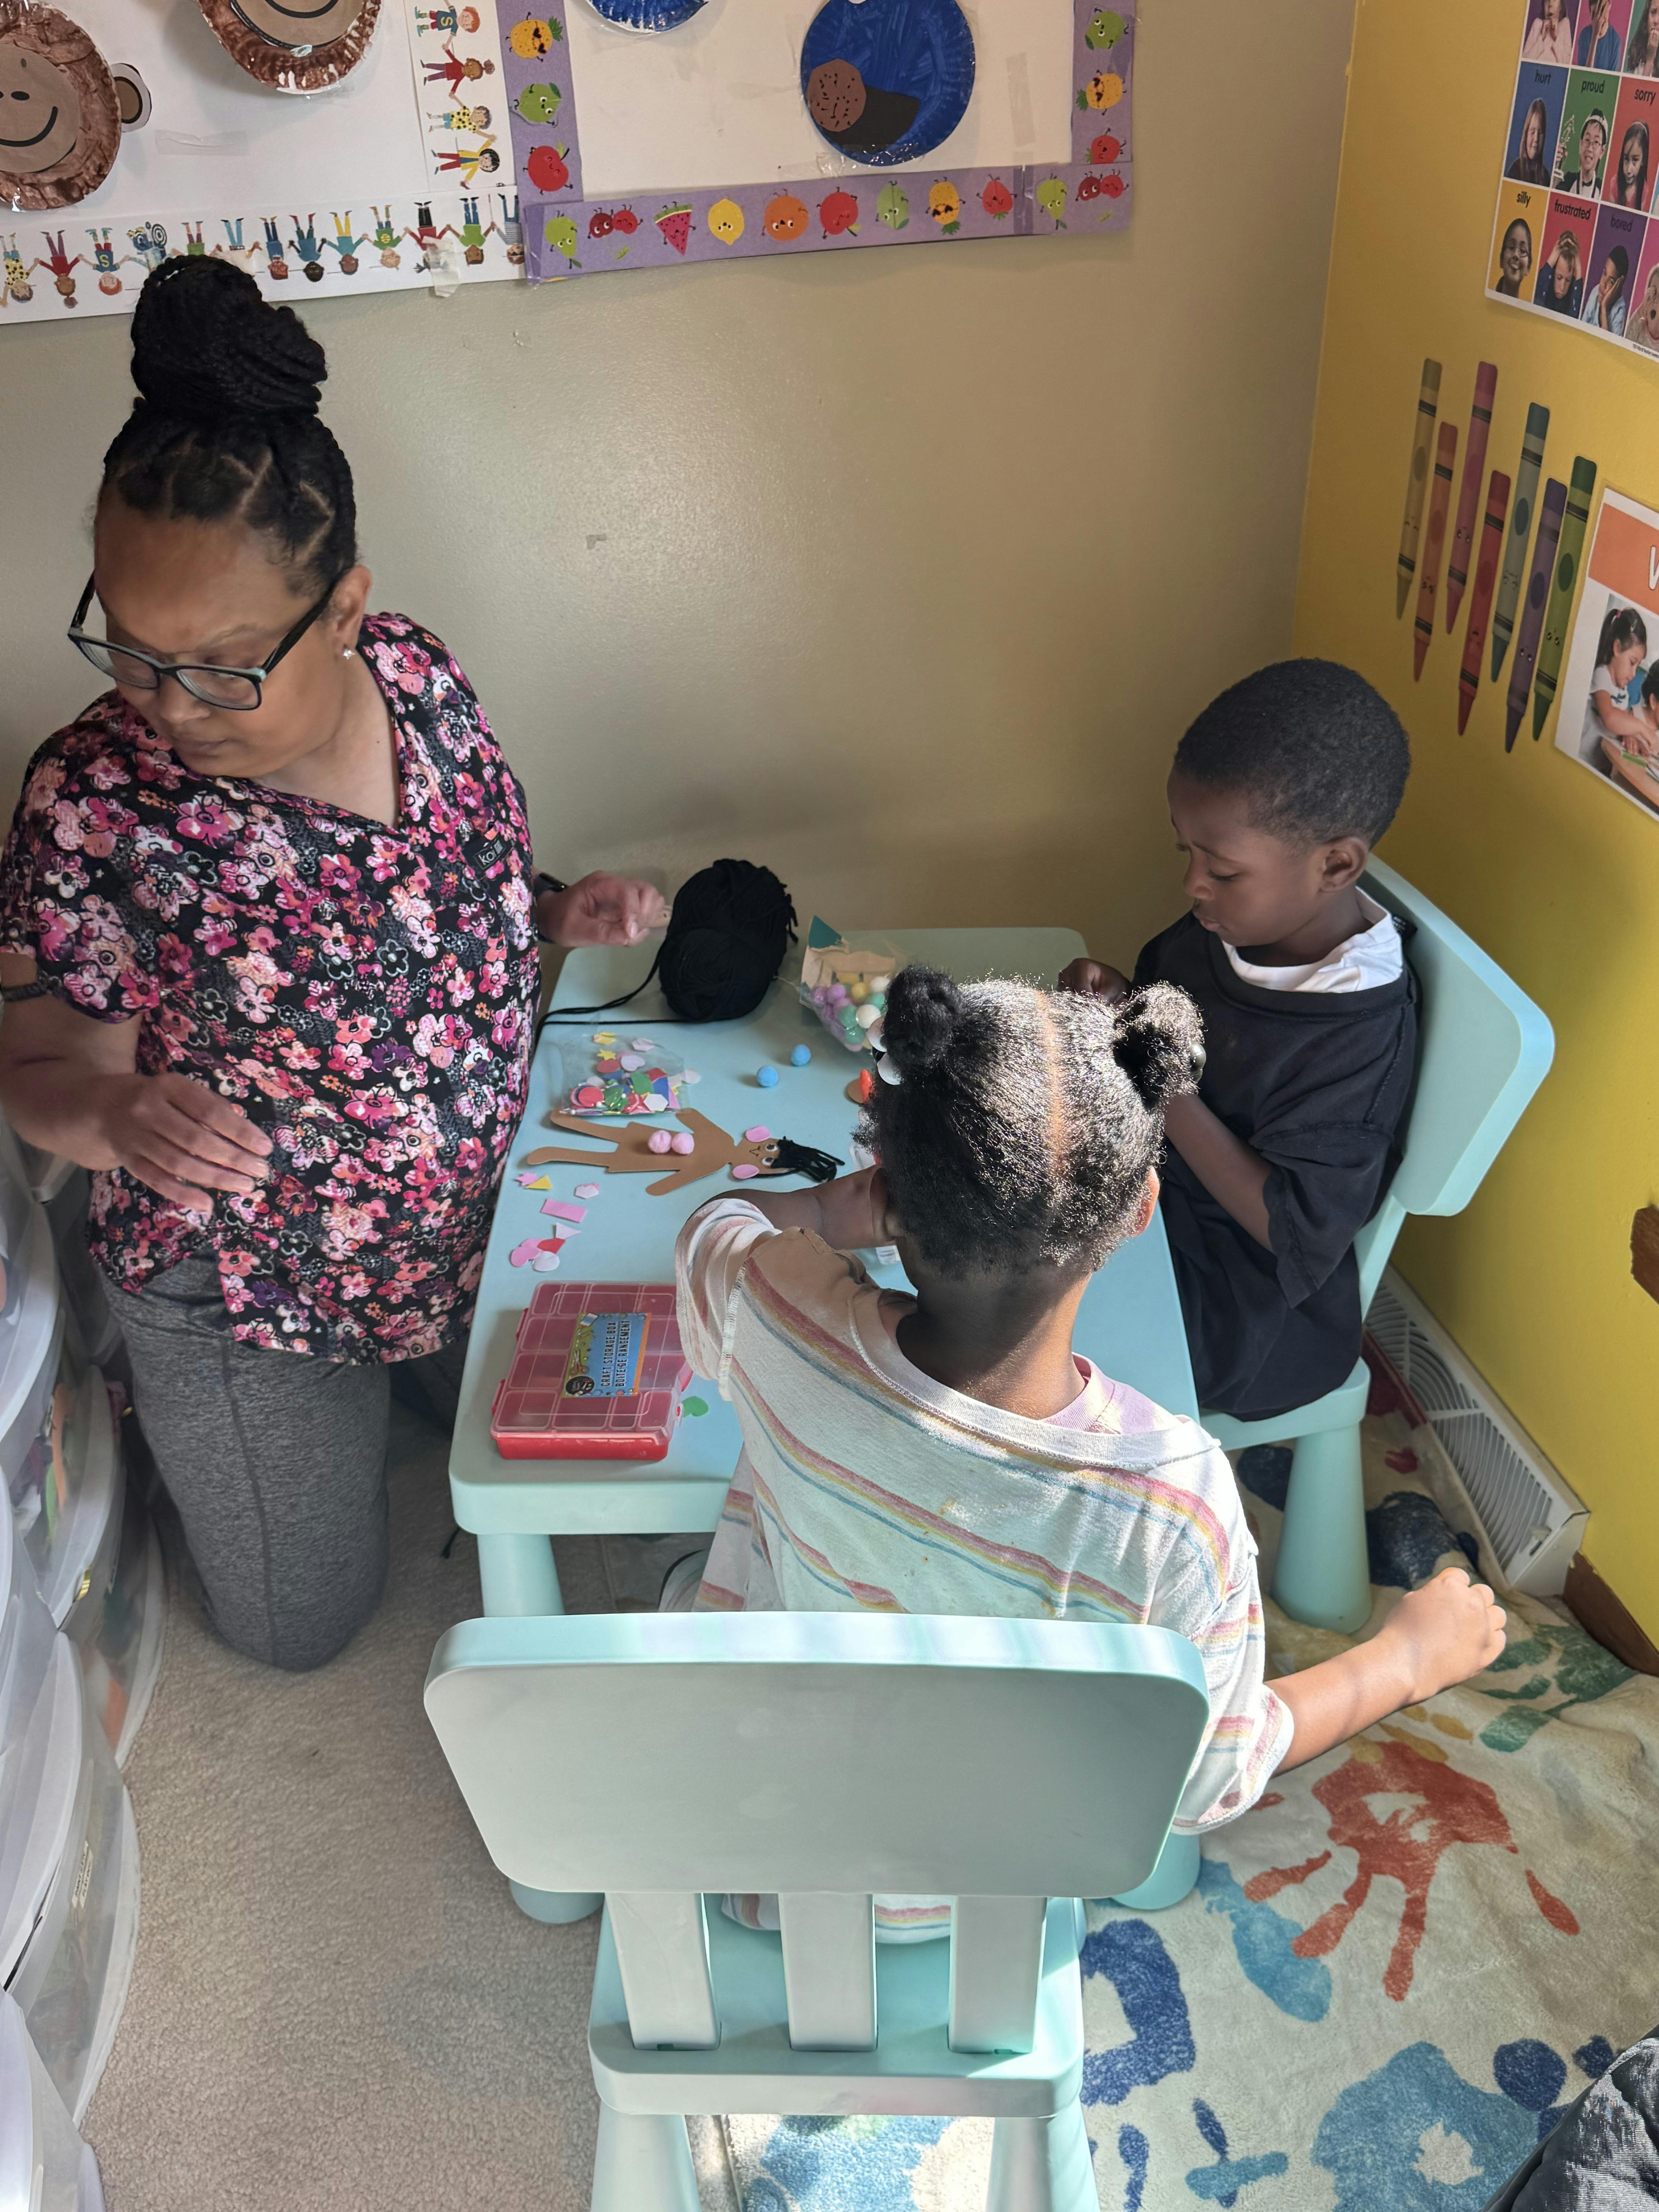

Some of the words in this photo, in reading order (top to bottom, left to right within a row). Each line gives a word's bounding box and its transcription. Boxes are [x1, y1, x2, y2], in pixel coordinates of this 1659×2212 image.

[1535, 69, 1551, 84] hurt
[1581, 80, 1605, 93] proud
[1634, 89, 1656, 106] sorry
[1516, 191, 1531, 208] silly
[1554, 199, 1591, 220] frustrated
[1610, 215, 1633, 232] bored
[606, 1322, 617, 1334] BOX
[618, 1321, 631, 1357] RANGEMENT
[603, 1336, 615, 1364] STORAGE
[601, 1367, 612, 1387] CRAFT
